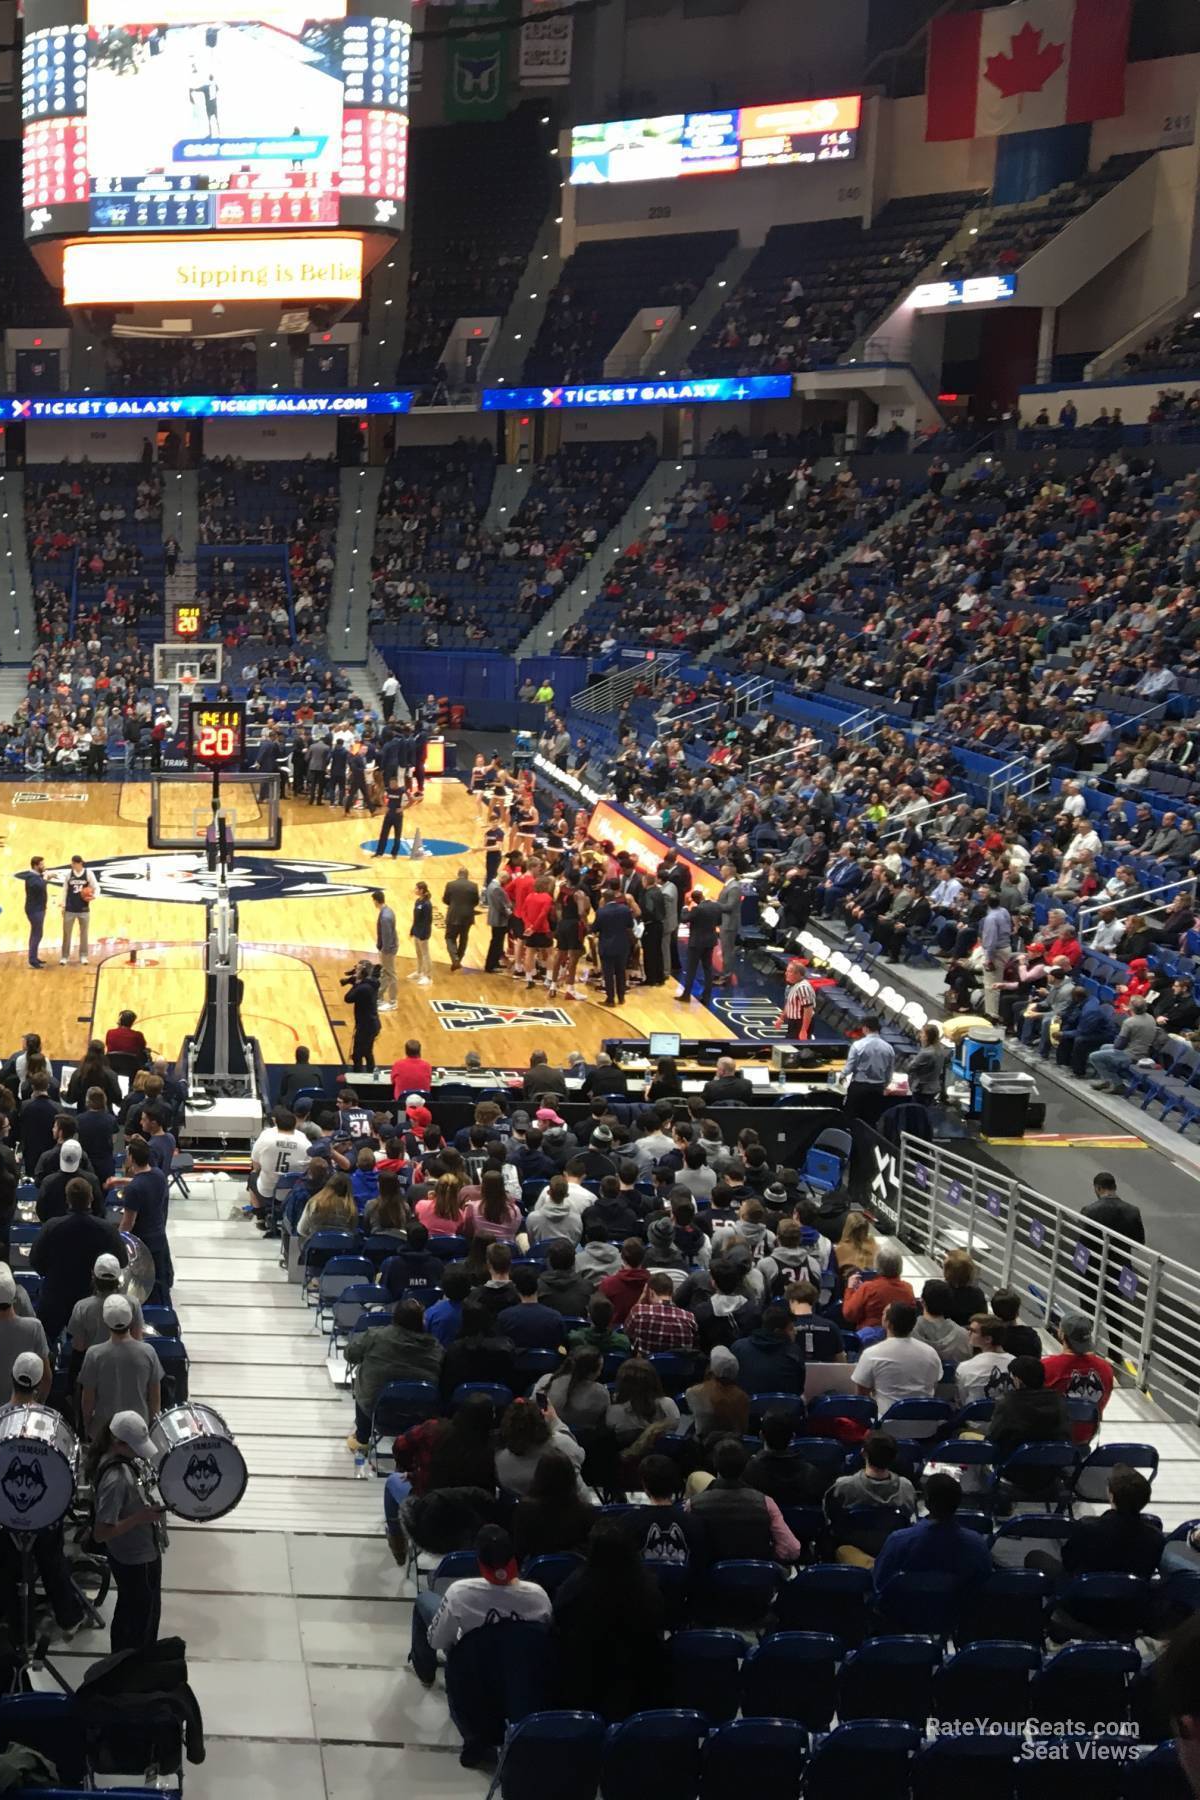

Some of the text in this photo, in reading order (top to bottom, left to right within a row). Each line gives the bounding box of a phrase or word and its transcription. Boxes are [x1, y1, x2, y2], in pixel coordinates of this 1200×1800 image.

[177, 264, 268, 288] Sipping
[275, 264, 293, 281] is
[565, 383, 719, 403] TICKET GALAXY
[34, 401, 182, 415] TICKET GALAXY
[211, 397, 367, 412] TICKETGALAXY.COM
[178, 616, 198, 633] 20
[199, 727, 233, 756] 20
[349, 1121, 370, 1137] 34
[275, 1152, 290, 1173] 15
